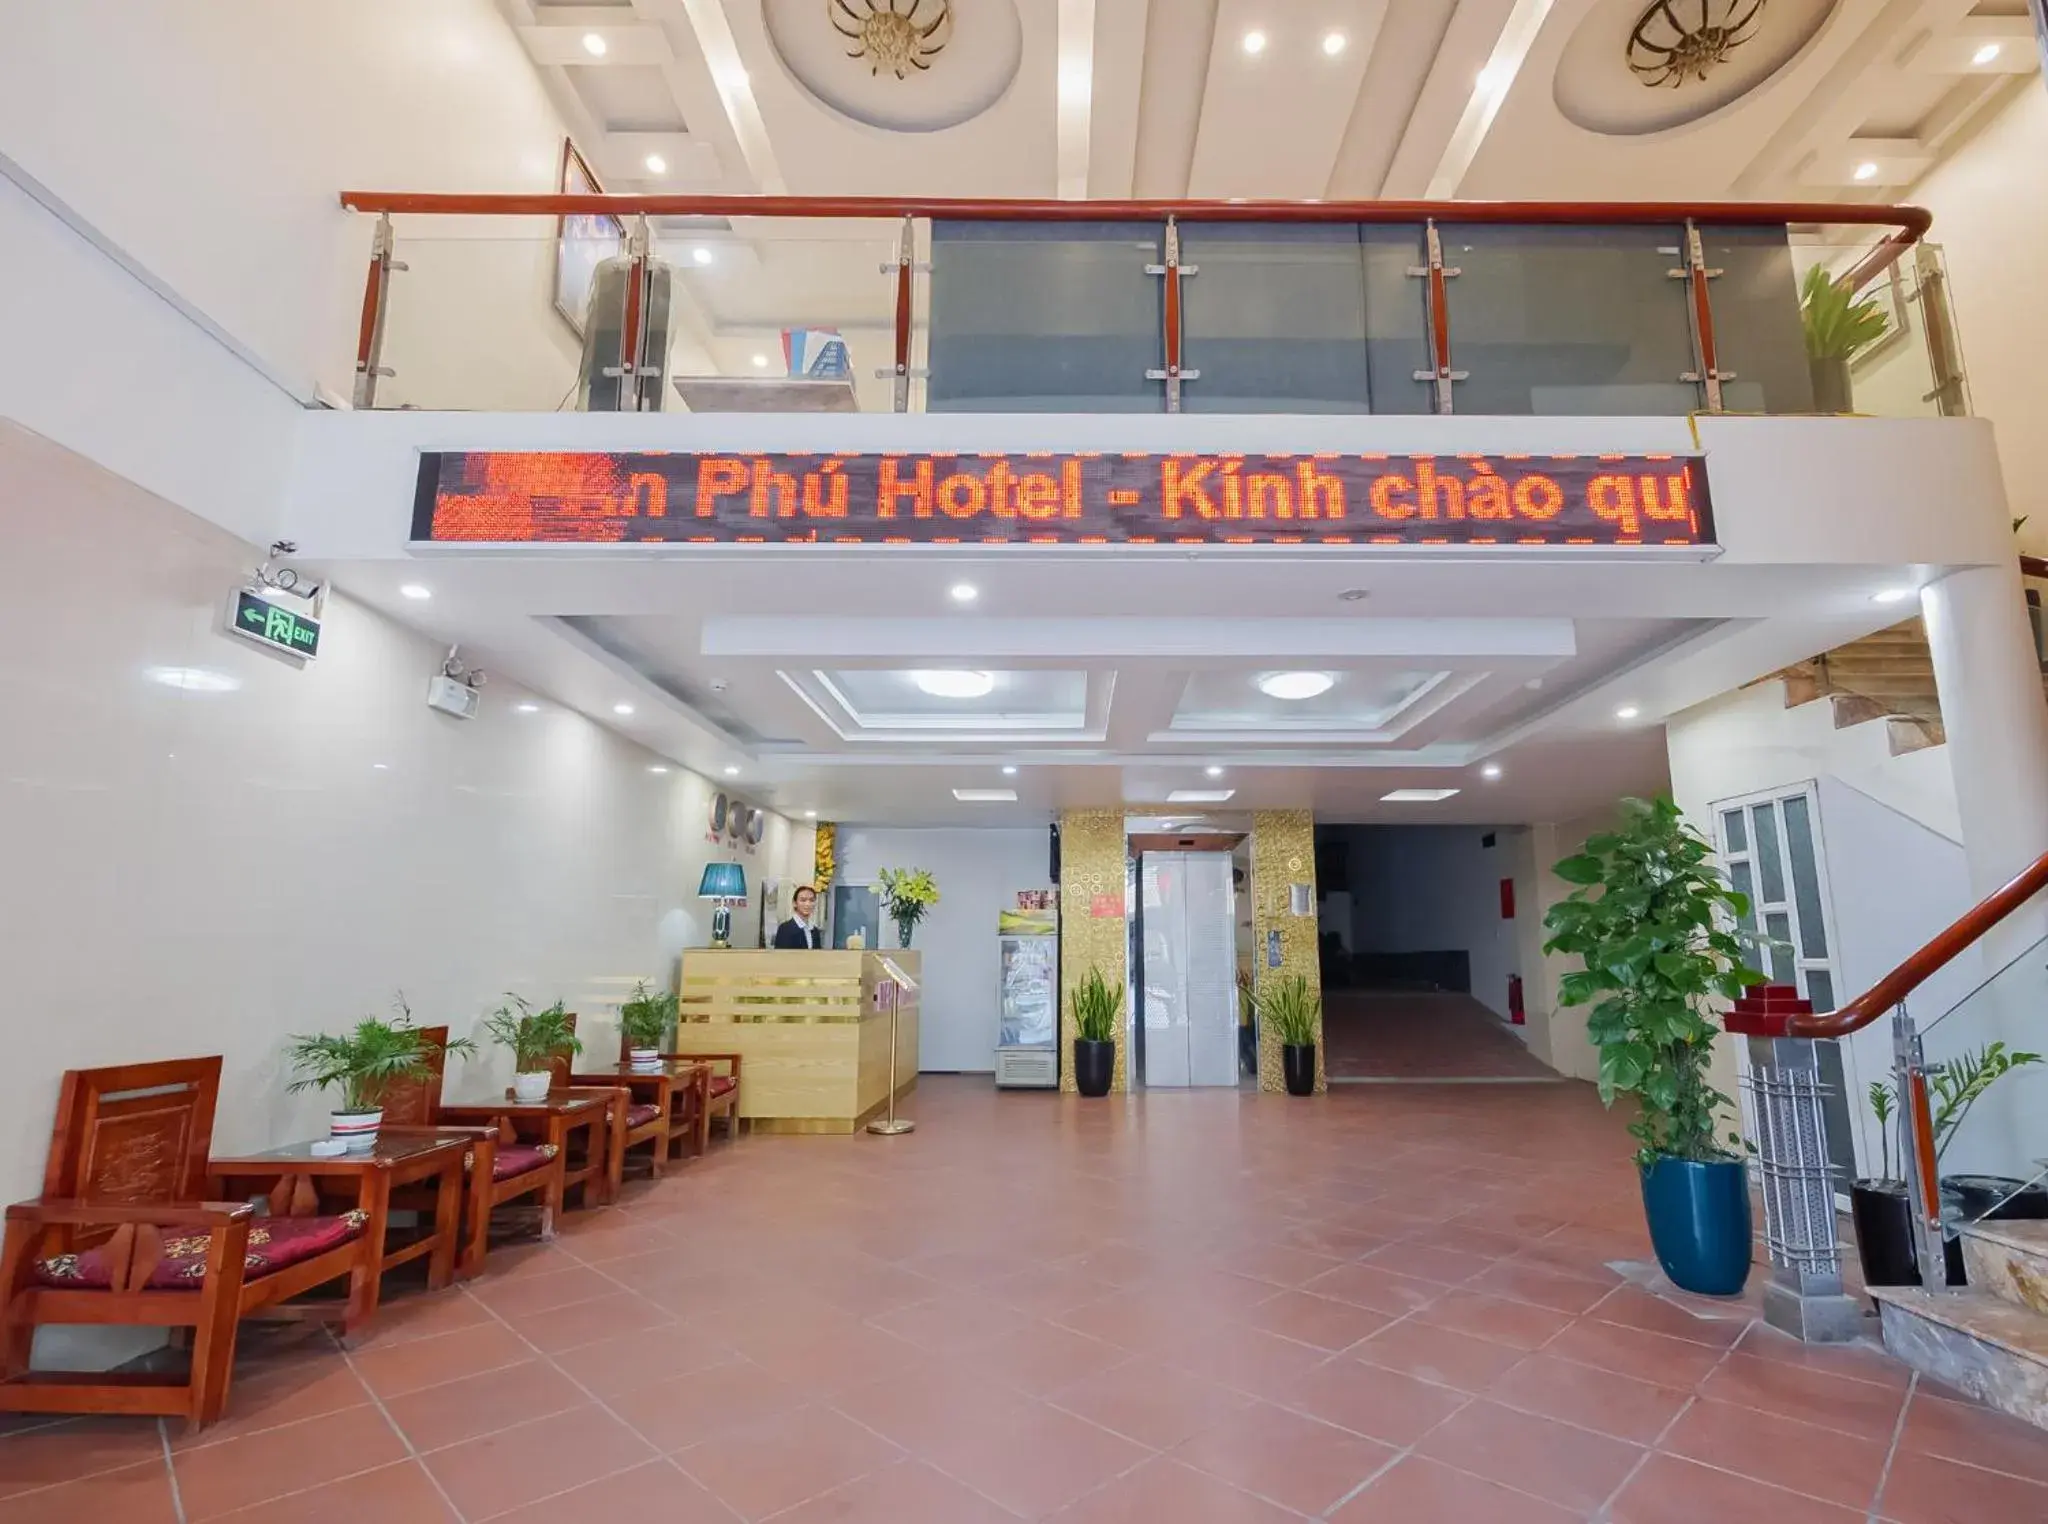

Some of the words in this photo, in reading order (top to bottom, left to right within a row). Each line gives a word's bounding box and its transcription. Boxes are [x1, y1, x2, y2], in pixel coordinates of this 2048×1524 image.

[695, 459, 849, 518] Phú
[877, 459, 1083, 519] Hotel
[1160, 459, 1347, 519] Kính
[1368, 460, 1566, 520] chào
[1586, 475, 1688, 534] qu
[294, 626, 315, 645] EXIT
